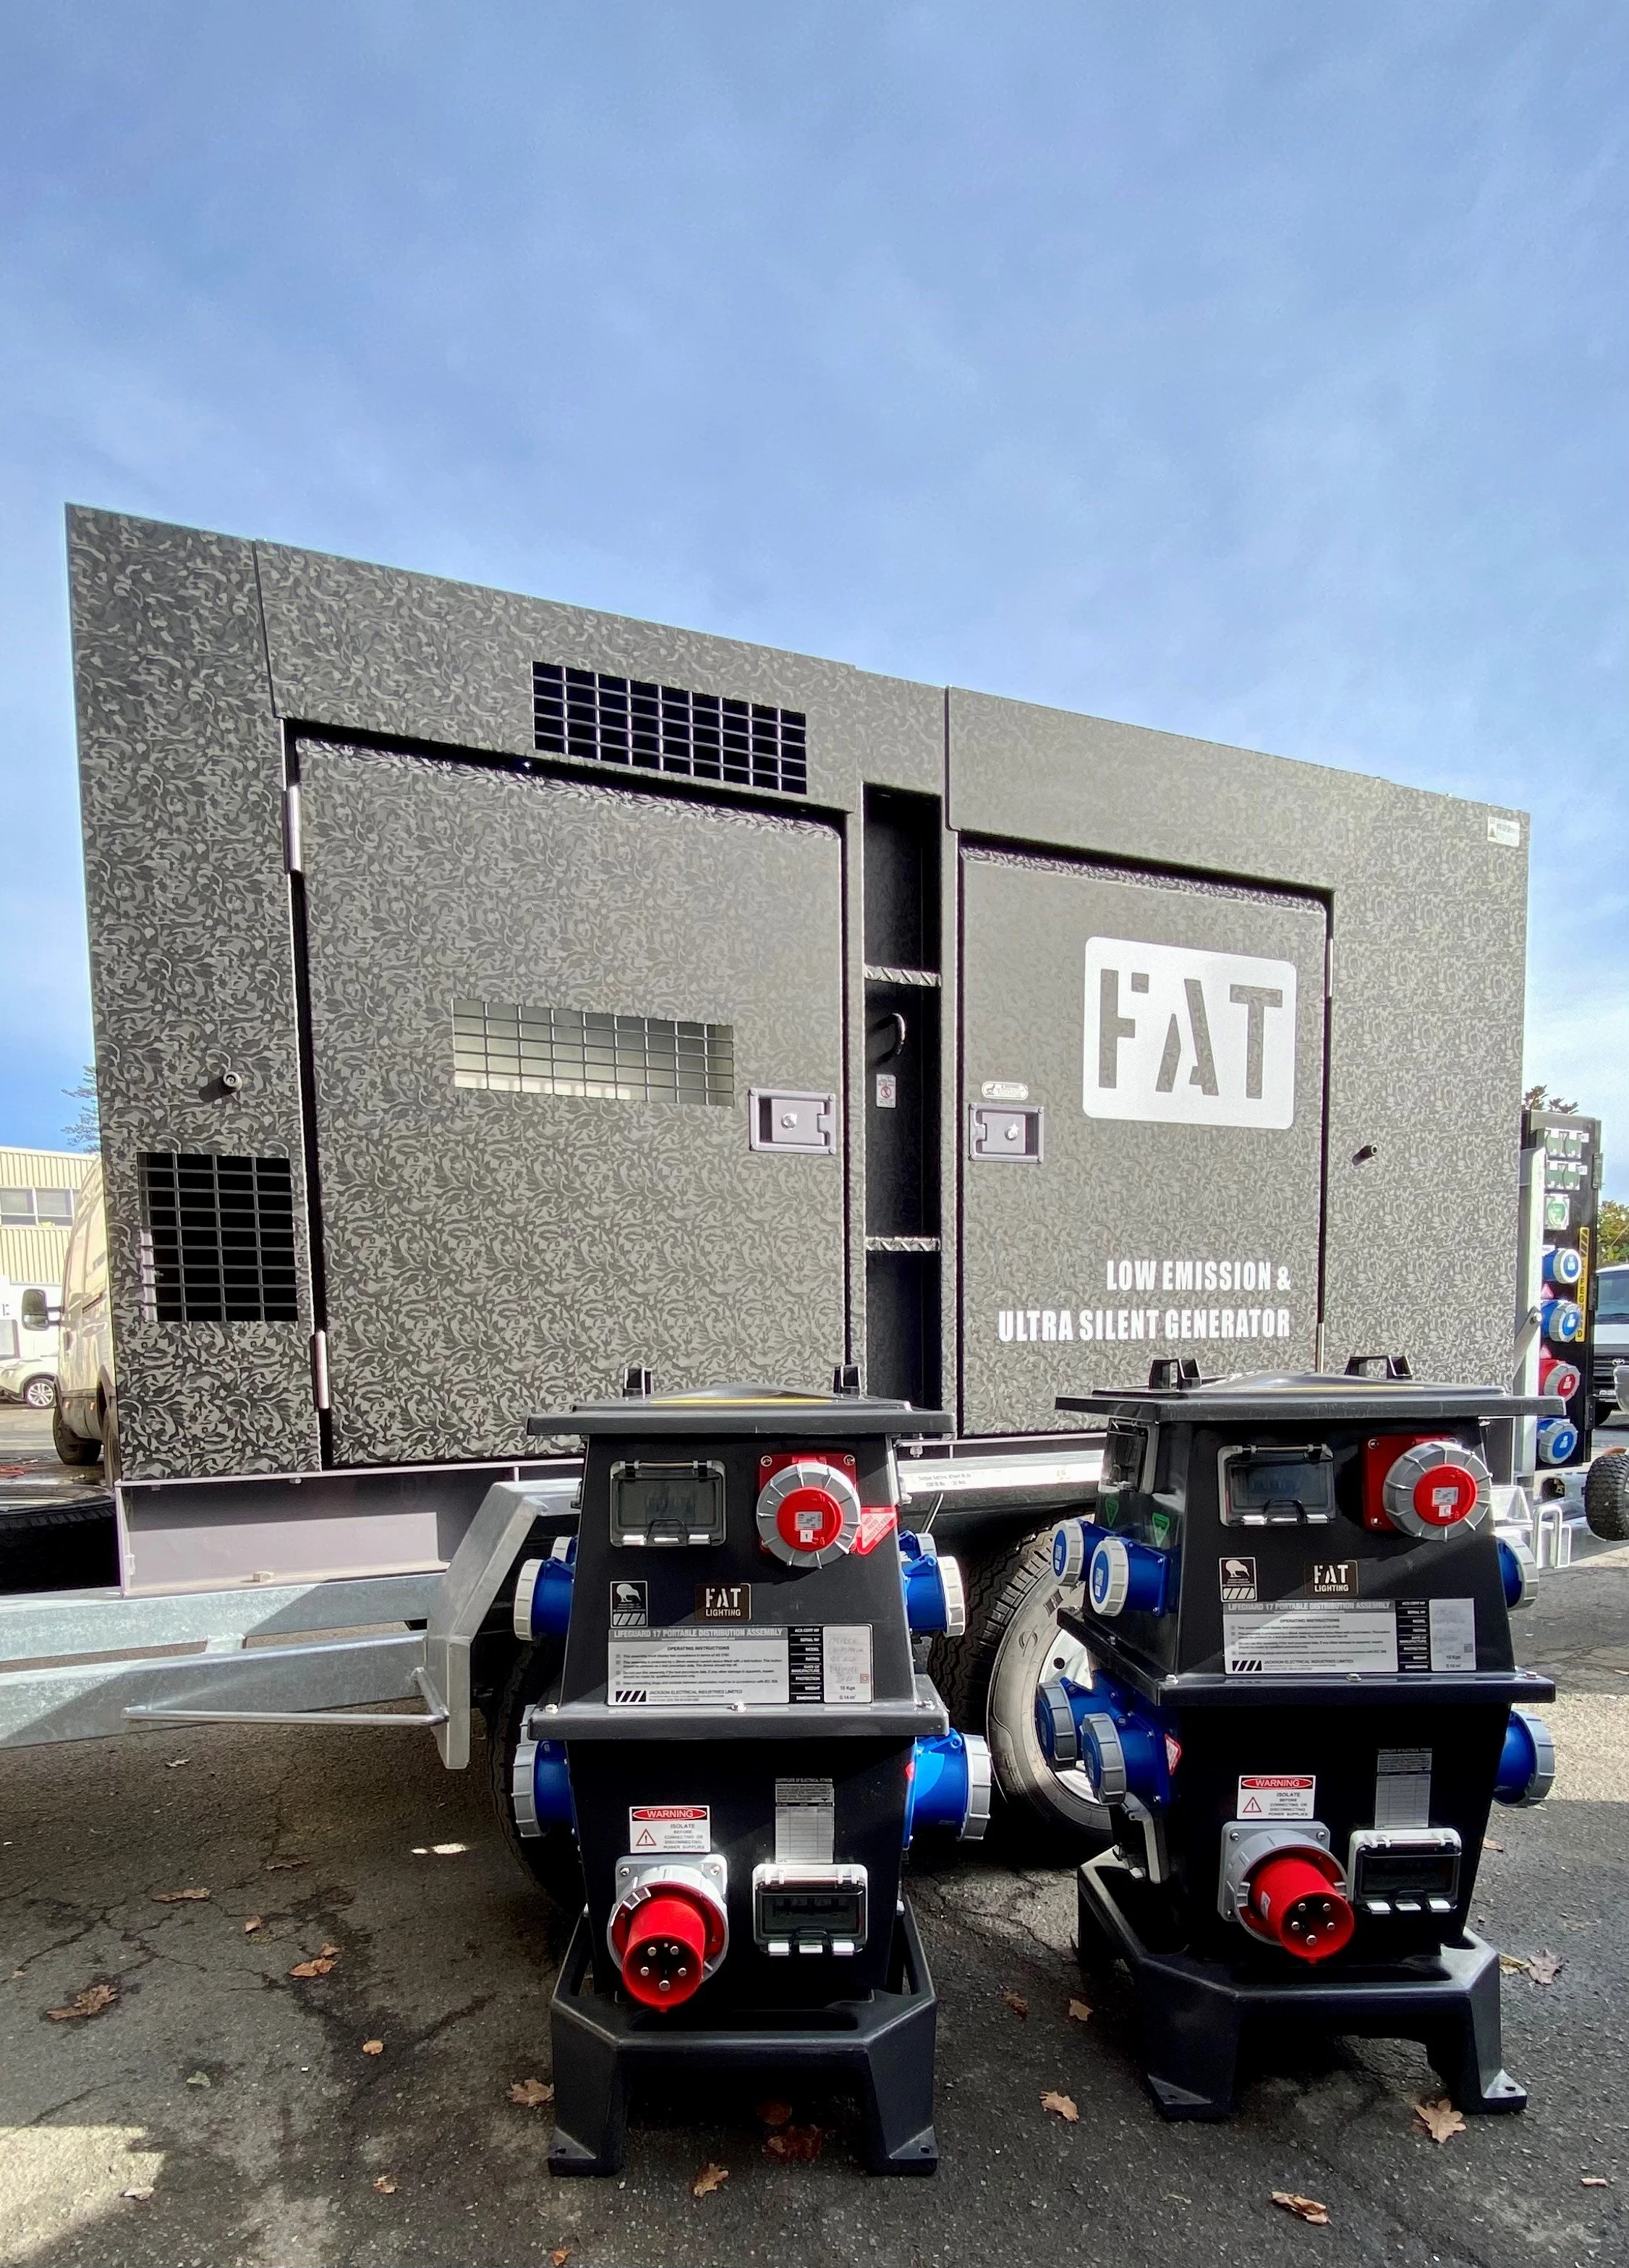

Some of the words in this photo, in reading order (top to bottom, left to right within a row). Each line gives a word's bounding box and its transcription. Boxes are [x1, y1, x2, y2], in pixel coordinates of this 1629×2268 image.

[1099, 968, 1283, 1099] FAT
[1107, 1260, 1157, 1291] LOW
[1163, 1261, 1272, 1291] EMISSION
[1277, 1266, 1292, 1291] &
[1577, 1257, 1586, 1338] LIFEGD
[998, 1310, 1073, 1342] ULTRA
[1079, 1309, 1160, 1341] SILENT
[1165, 1309, 1290, 1339] GENERATOR
[1314, 1564, 1349, 1584] FAT
[705, 1588, 741, 1607] FAT
[647, 1809, 694, 1818] WARNING
